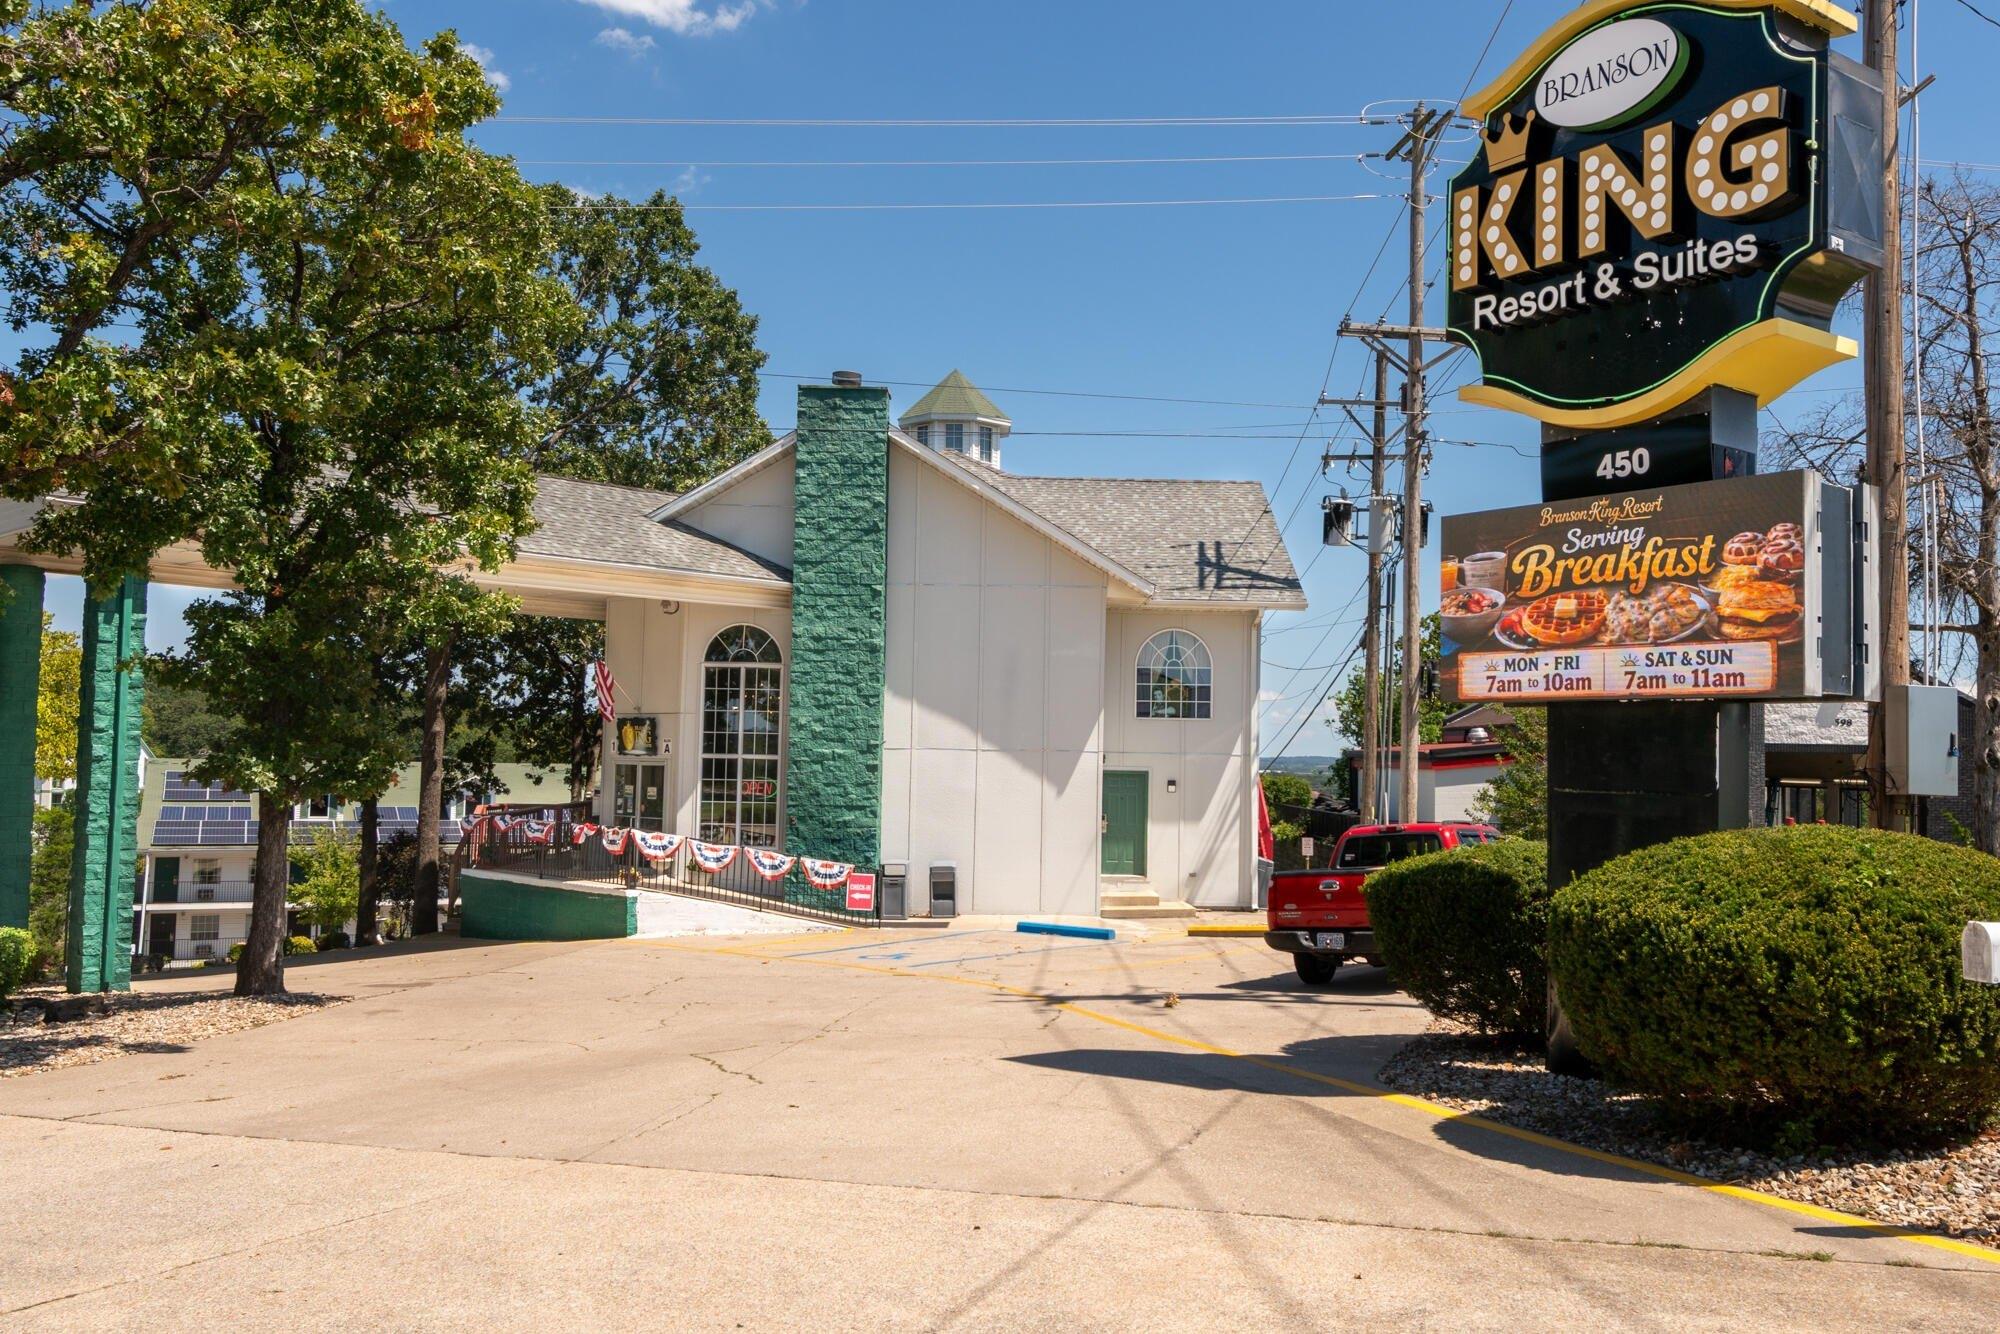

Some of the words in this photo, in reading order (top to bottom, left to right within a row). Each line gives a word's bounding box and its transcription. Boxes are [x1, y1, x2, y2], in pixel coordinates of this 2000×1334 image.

[1543, 39, 1669, 107] BRANSON
[1453, 86, 1789, 291] KING
[1474, 271, 1586, 330] Resort
[1594, 262, 1621, 299] &
[1632, 234, 1758, 289] Suites
[1596, 448, 1650, 479] 450
[1540, 507, 1588, 527] Branson
[1588, 499, 1620, 525] King
[1620, 495, 1664, 519] Resort
[1562, 526, 1645, 554] Serving
[1511, 534, 1716, 597] Breakfast
[1504, 657, 1539, 672] MON
[1555, 656, 1580, 670] FRI
[1645, 652, 1677, 667] SAT
[1680, 651, 1692, 666] &
[1696, 649, 1733, 665] SUN
[1486, 675, 1522, 692] 7am
[1528, 678, 1539, 688] to
[1543, 673, 1592, 691] 10am
[1624, 671, 1666, 689] 7am
[1673, 673, 1685, 684] to
[1691, 668, 1745, 688] 11am
[664, 743, 670, 753] A
[742, 782, 772, 795] OPEN
